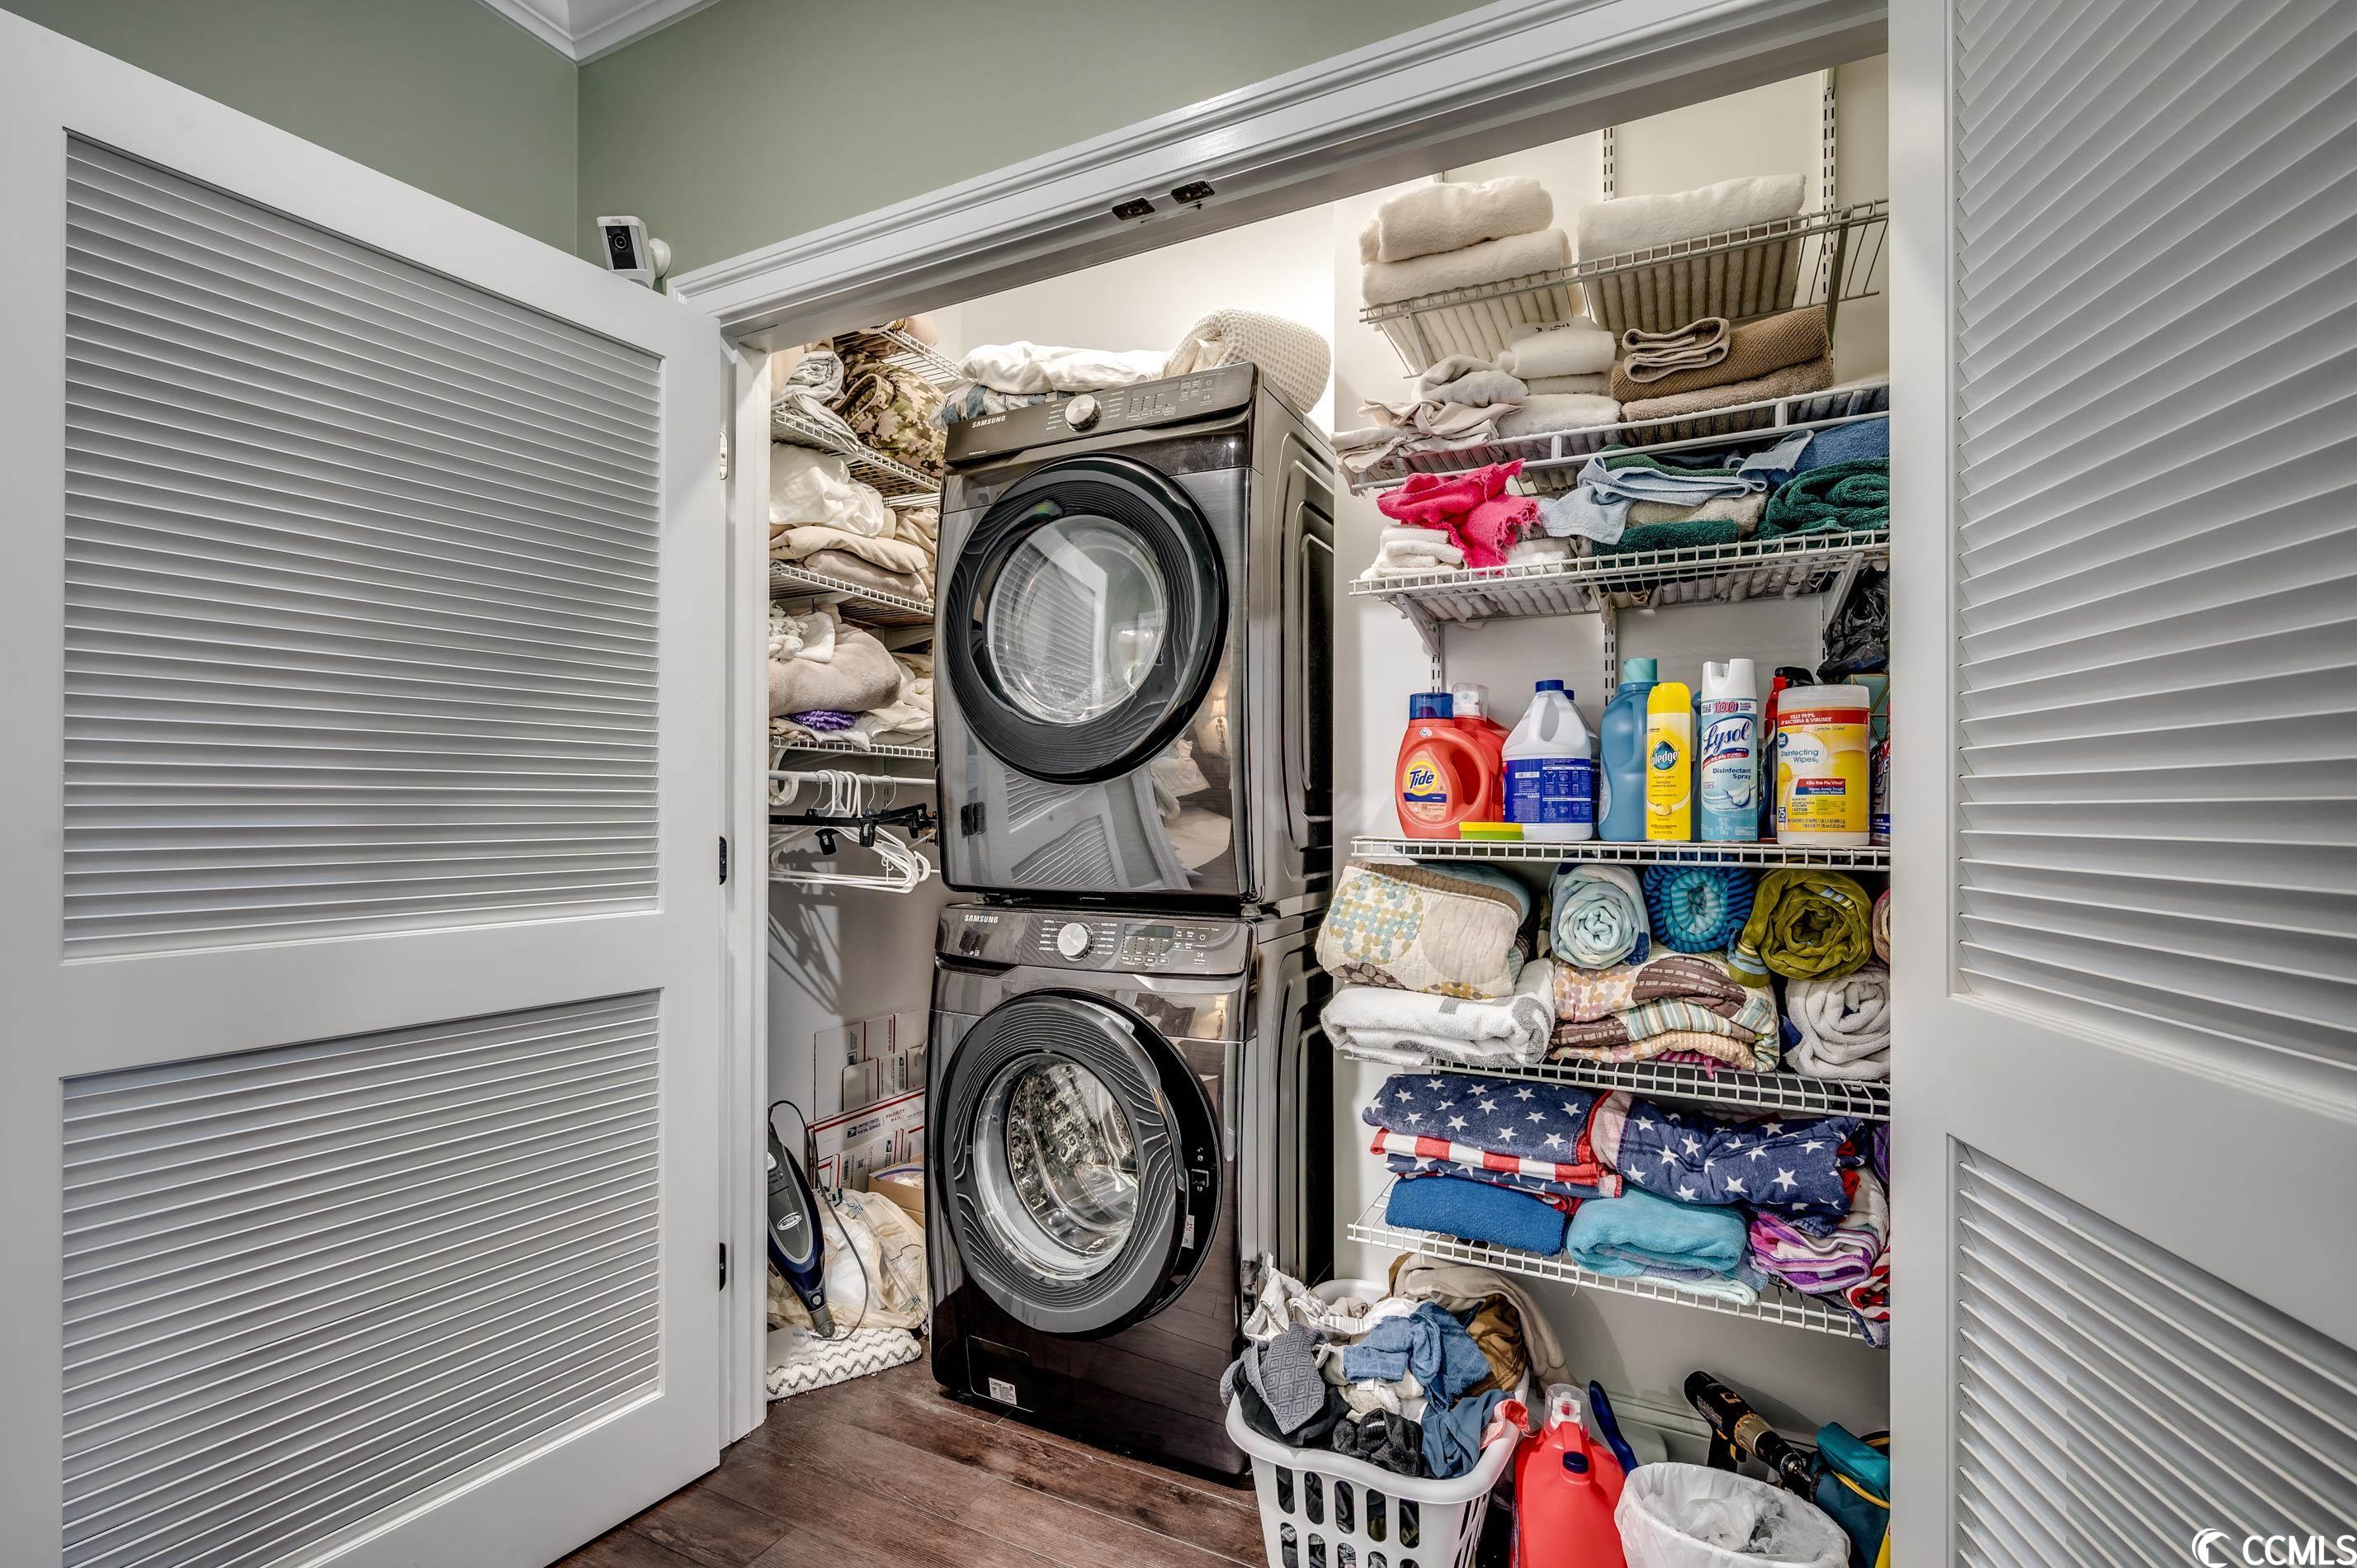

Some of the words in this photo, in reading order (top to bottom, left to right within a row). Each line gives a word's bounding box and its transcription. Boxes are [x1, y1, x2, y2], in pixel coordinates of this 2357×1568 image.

[971, 415, 1006, 428] SAMSUNG
[1713, 701, 1738, 714] 100
[1703, 720, 1750, 754] Lysol
[1651, 750, 1679, 770] pledge
[1409, 769, 1435, 790] Tide
[1778, 808, 1785, 818] 75
[964, 914, 999, 923] SAMSUNG
[886, 1109, 905, 1118] PRIORITY
[782, 1216, 797, 1227] Shark
